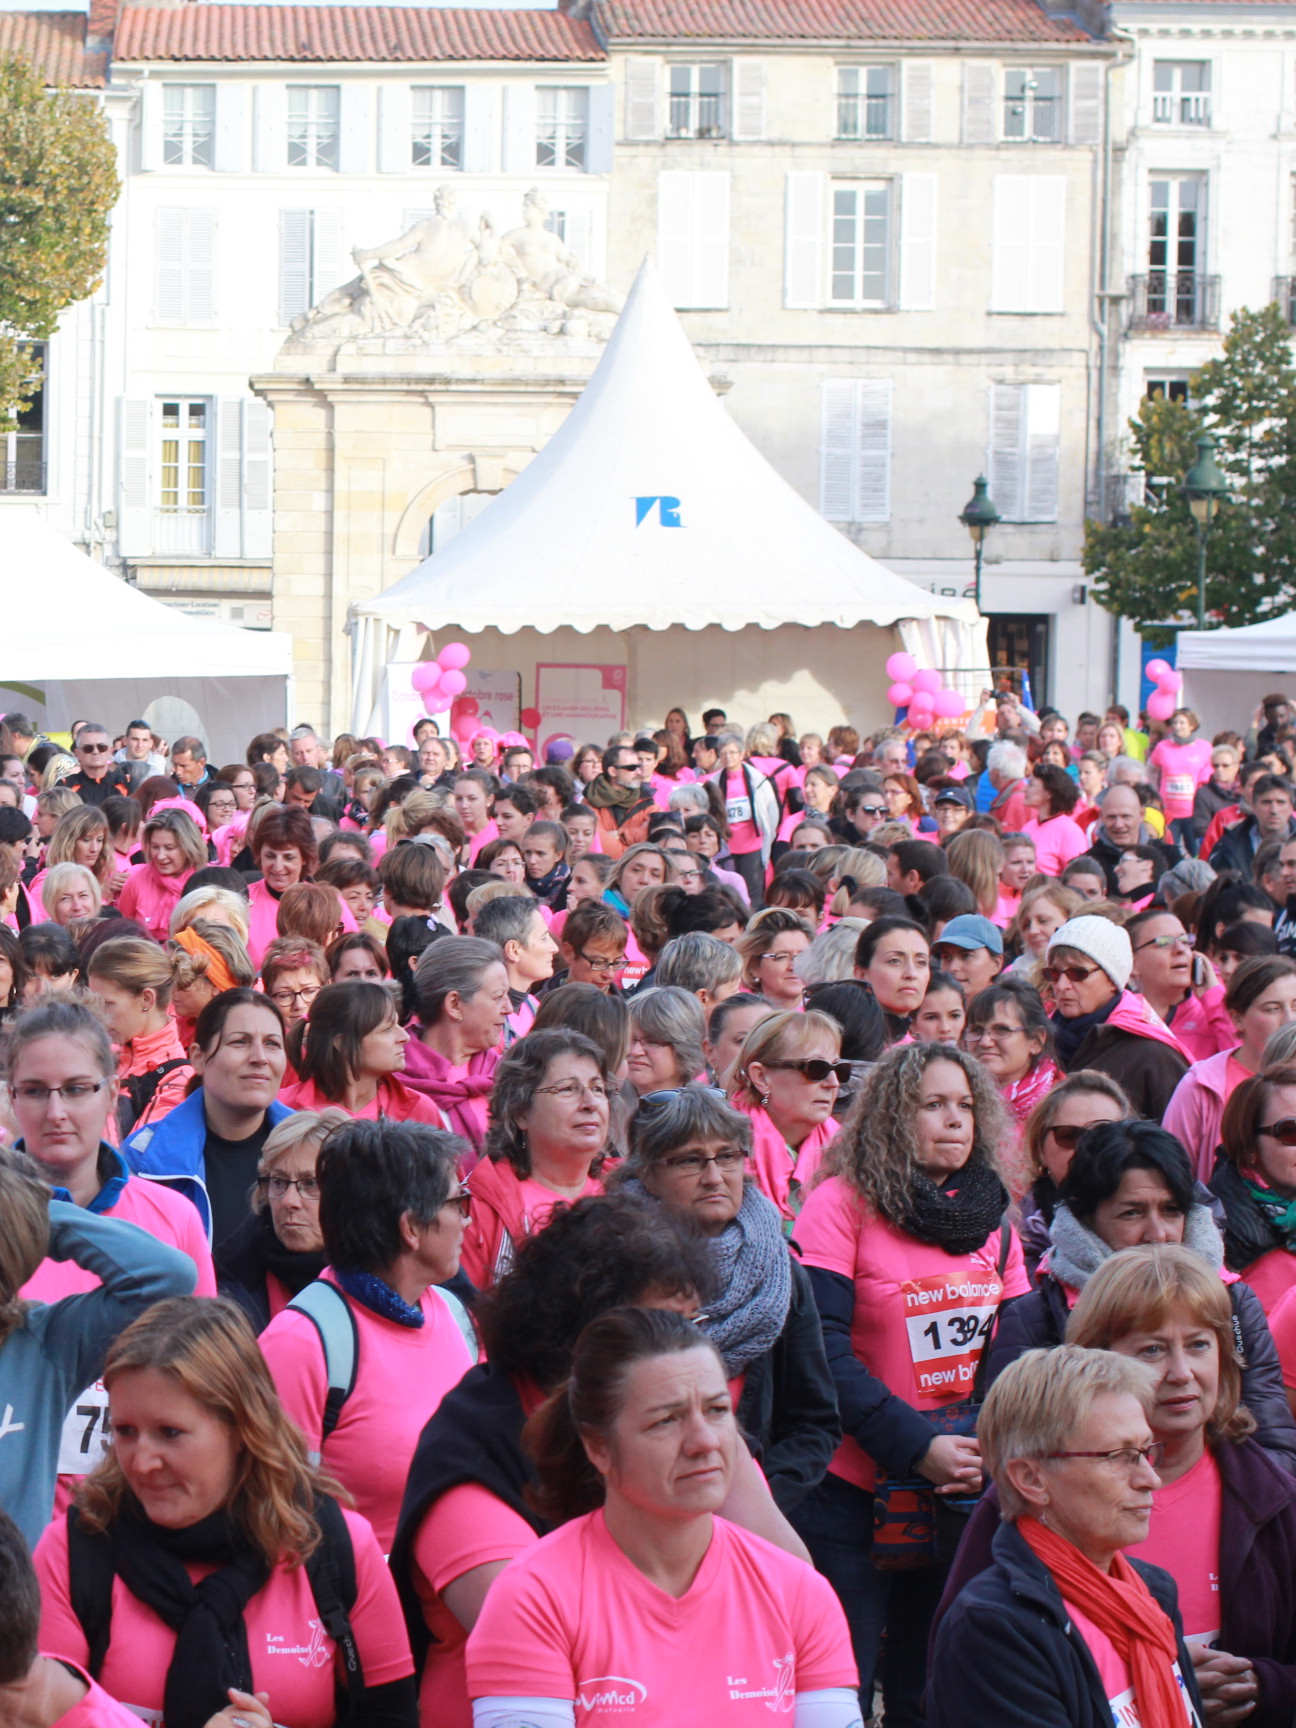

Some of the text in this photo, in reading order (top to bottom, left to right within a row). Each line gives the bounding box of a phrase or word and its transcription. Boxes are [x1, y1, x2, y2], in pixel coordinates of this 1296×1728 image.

[495, 689, 514, 701] rose
[907, 1281, 1000, 1307] new balance
[1232, 1315, 1244, 1354] Quechua
[920, 1369, 956, 1388] new
[266, 1633, 284, 1642] Les
[727, 1675, 748, 1686] Les
